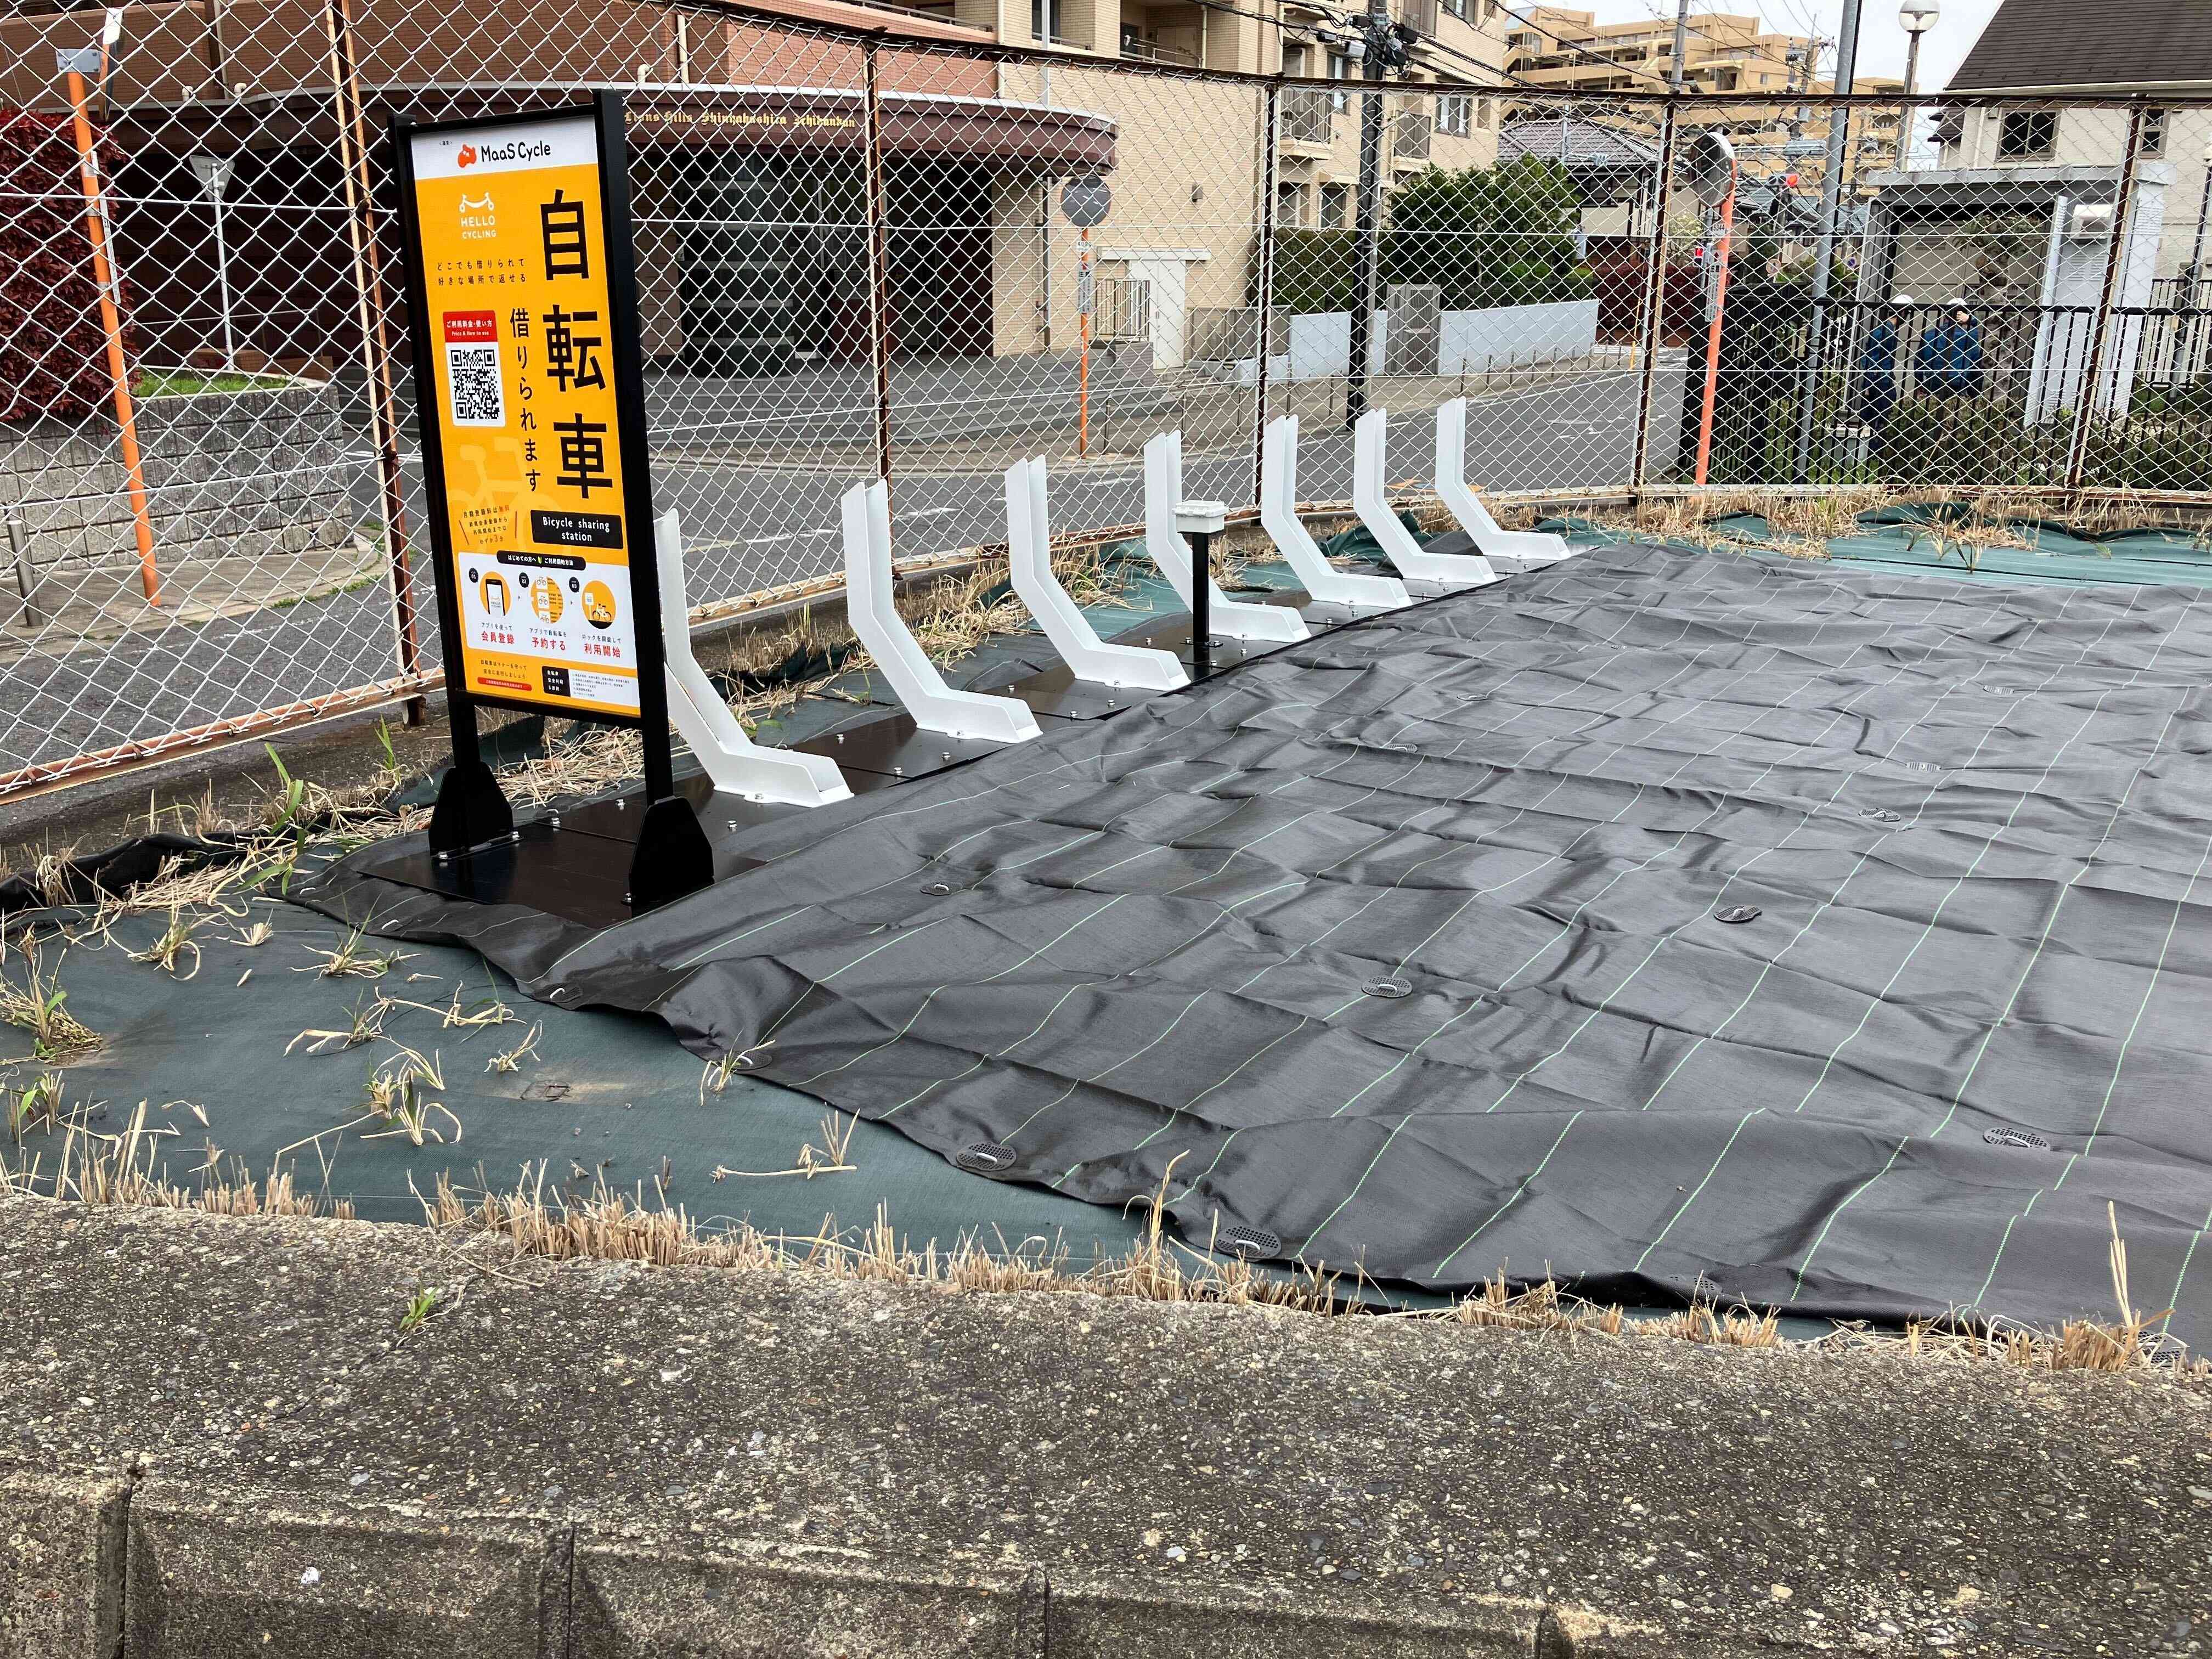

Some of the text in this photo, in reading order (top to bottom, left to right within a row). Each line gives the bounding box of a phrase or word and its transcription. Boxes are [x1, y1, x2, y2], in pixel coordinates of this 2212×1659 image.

[481, 140, 551, 162] MaaS Cycle
[460, 215, 495, 227] HELLO
[461, 229, 496, 239] CYCLING
[437, 258, 524, 271] どこでも借りられて
[438, 274, 526, 286] 好きな場所で返せる
[540, 189, 613, 499] 自転車
[510, 308, 541, 492] 借りられます
[543, 516, 610, 533] Bicycle sharing
[561, 531, 592, 541] station
[481, 630, 515, 645] 会員登録
[532, 636, 566, 651] 予約する
[584, 643, 620, 658] 利用開始
